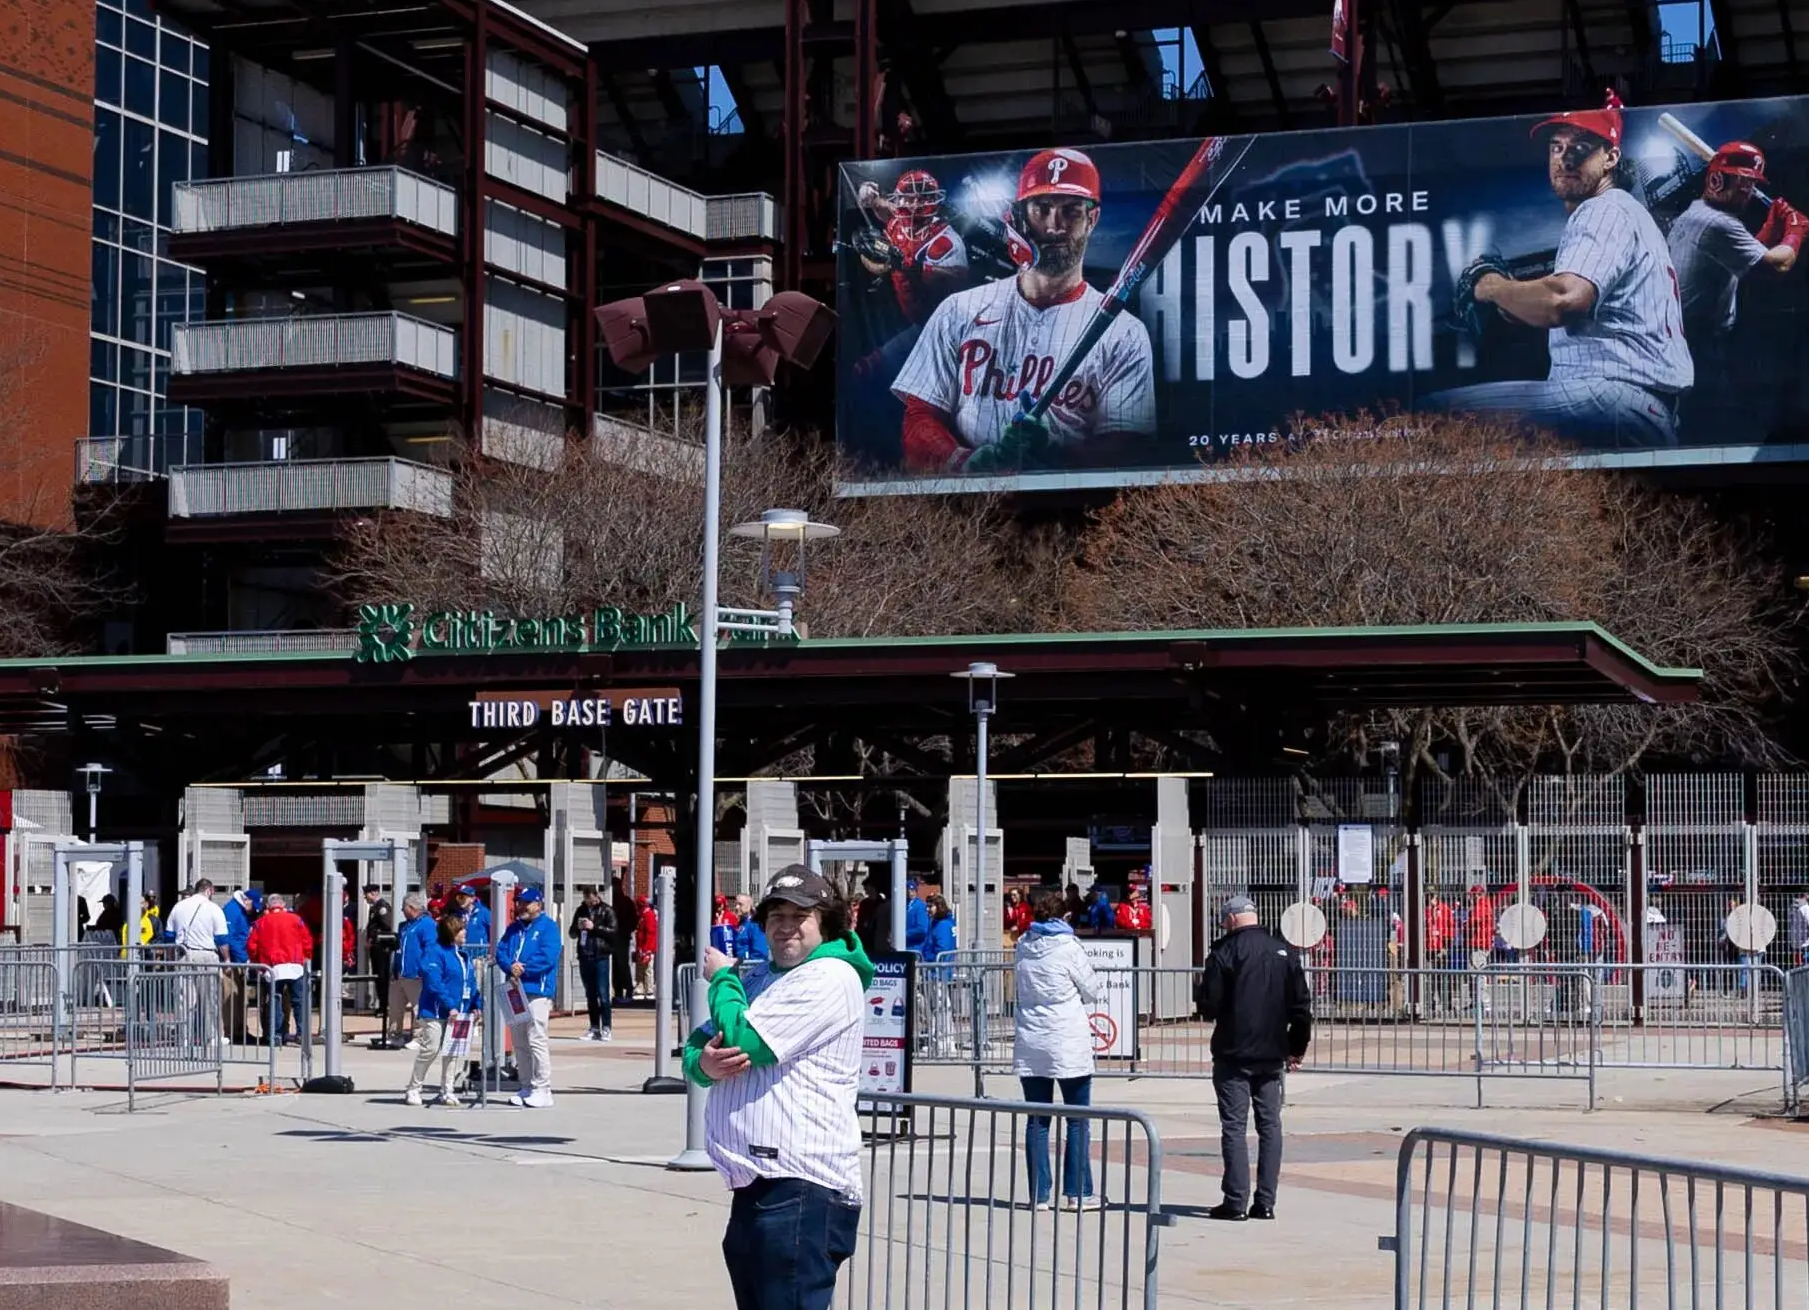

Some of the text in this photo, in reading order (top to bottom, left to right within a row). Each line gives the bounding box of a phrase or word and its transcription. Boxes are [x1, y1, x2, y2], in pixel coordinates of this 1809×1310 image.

[1200, 189, 1430, 225] MAKE MORE
[1189, 434, 1210, 447] 20
[1219, 431, 1279, 446] YEARS
[421, 607, 587, 651] Citizens
[593, 601, 699, 645] Bank
[469, 696, 684, 728] THIRD BASE GATE
[1087, 948, 1124, 959] oking is
[879, 979, 898, 987] BAGS
[1106, 979, 1131, 990] Bank
[1094, 996, 1109, 1005] ark
[879, 1038, 899, 1048] BAGS
